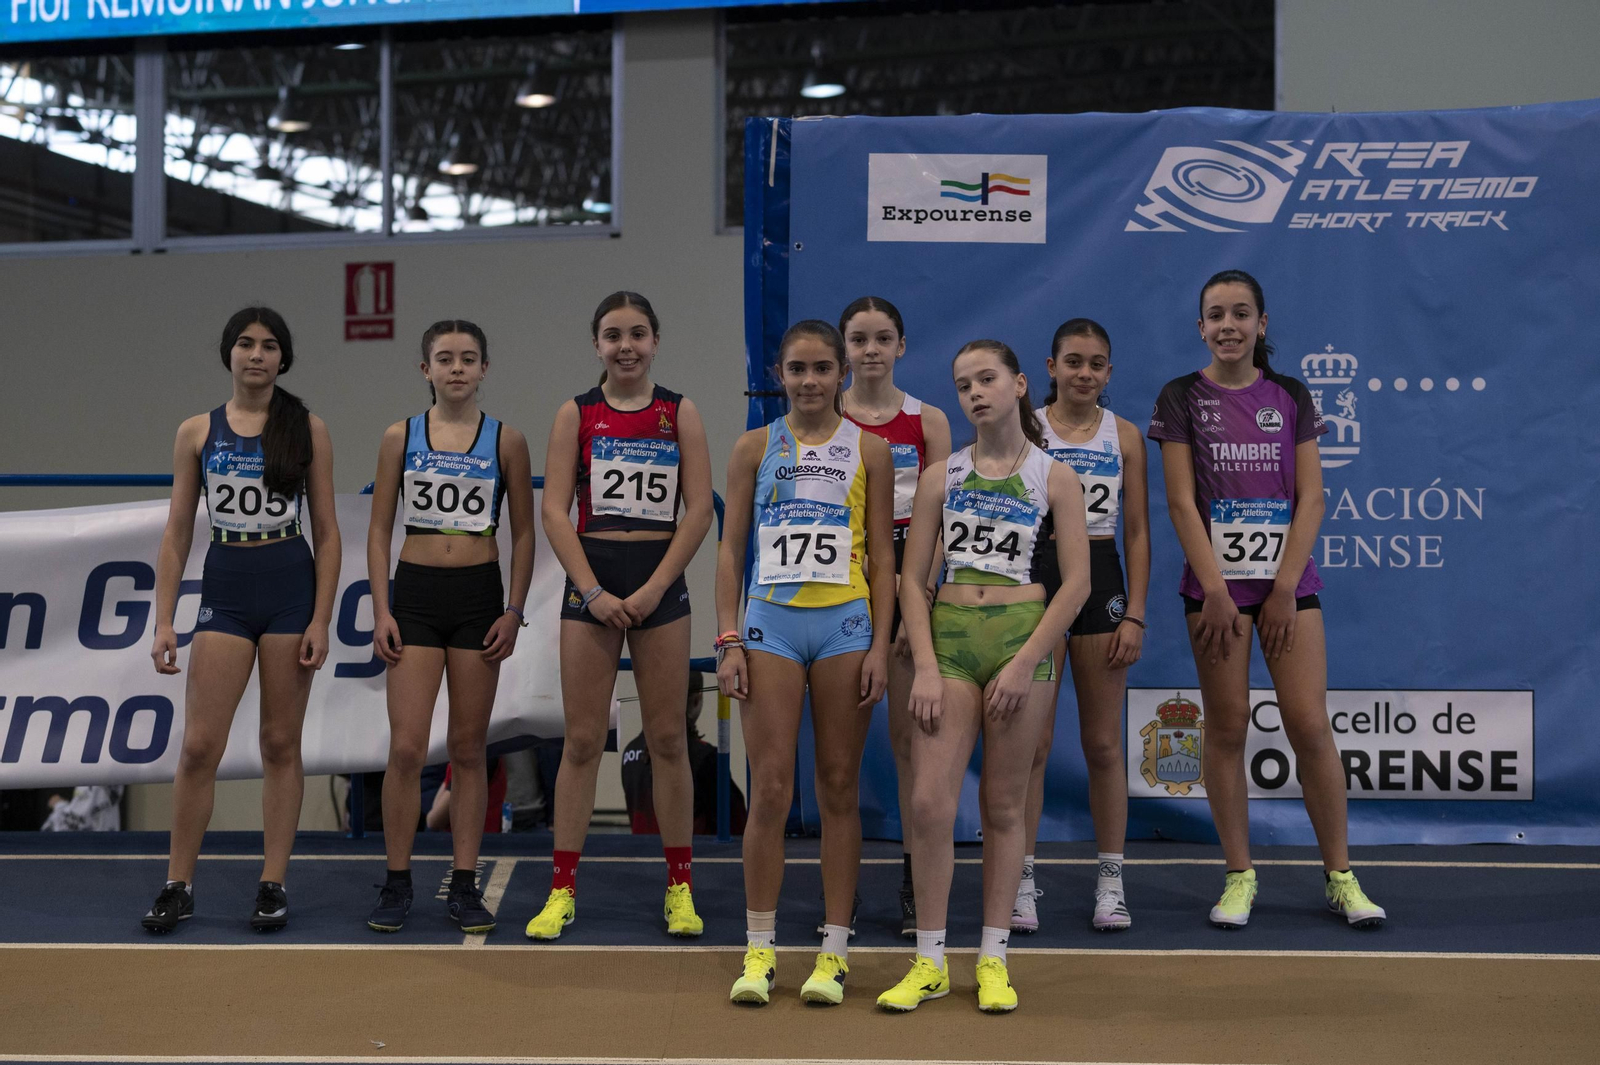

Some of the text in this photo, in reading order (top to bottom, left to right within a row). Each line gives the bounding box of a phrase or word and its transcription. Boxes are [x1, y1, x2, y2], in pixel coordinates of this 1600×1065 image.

[1299, 176, 1540, 201] ATLETISMO
[882, 206, 1034, 225] Expourense
[1288, 210, 1510, 232] SHORT TRACK
[611, 439, 676, 453] Federación Galega
[621, 447, 659, 458] Atletismo
[890, 445, 912, 455] alega
[1209, 442, 1282, 461] TAMBRE
[227, 453, 264, 464] Federación
[235, 461, 266, 472] Atletis
[426, 452, 463, 464] Federación
[435, 460, 472, 471] Atletismo
[1053, 450, 1115, 465] Federación Galega
[1213, 461, 1281, 472] ATLETISMO
[775, 464, 847, 481] Quescrem
[602, 469, 668, 504] 215
[215, 483, 288, 518] 205
[412, 480, 486, 516] 306
[1003, 497, 1034, 516] Galega
[1231, 500, 1288, 512] Federación Galega
[778, 509, 826, 520] de Atletismo
[779, 501, 847, 518] Federación Galega
[963, 500, 1012, 515] de Atletismo
[1231, 508, 1274, 518] de Atletismo
[772, 532, 838, 567] 175
[948, 521, 1022, 562] 254
[1222, 531, 1284, 563] 327
[1315, 535, 1445, 569] ENSE
[1250, 700, 1476, 735] Ccello de
[0, 694, 174, 765] mo
[1249, 748, 1518, 792] ORENSE
